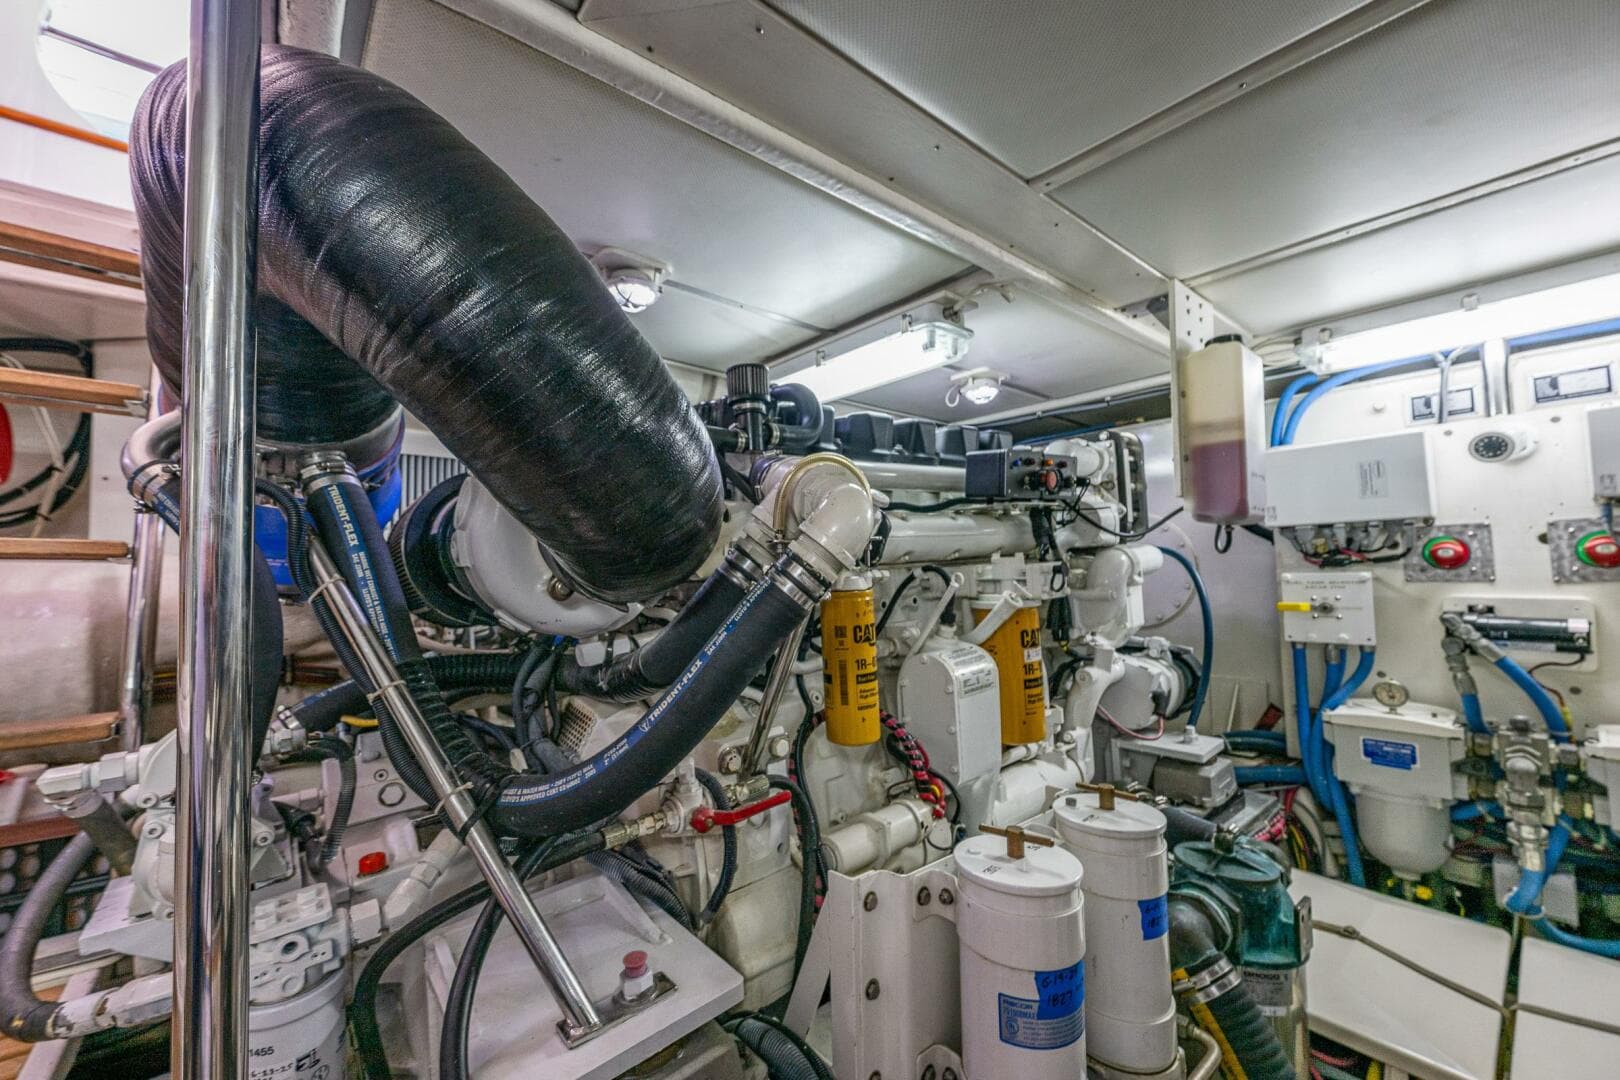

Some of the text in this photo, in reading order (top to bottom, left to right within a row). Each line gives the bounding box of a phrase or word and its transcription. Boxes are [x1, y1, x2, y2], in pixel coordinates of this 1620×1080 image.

[327, 484, 358, 547] TRIDENT-FLEX
[853, 623, 875, 644] CAT
[1021, 629, 1041, 648] CAT
[648, 658, 703, 721] TRIDENT-FLEX
